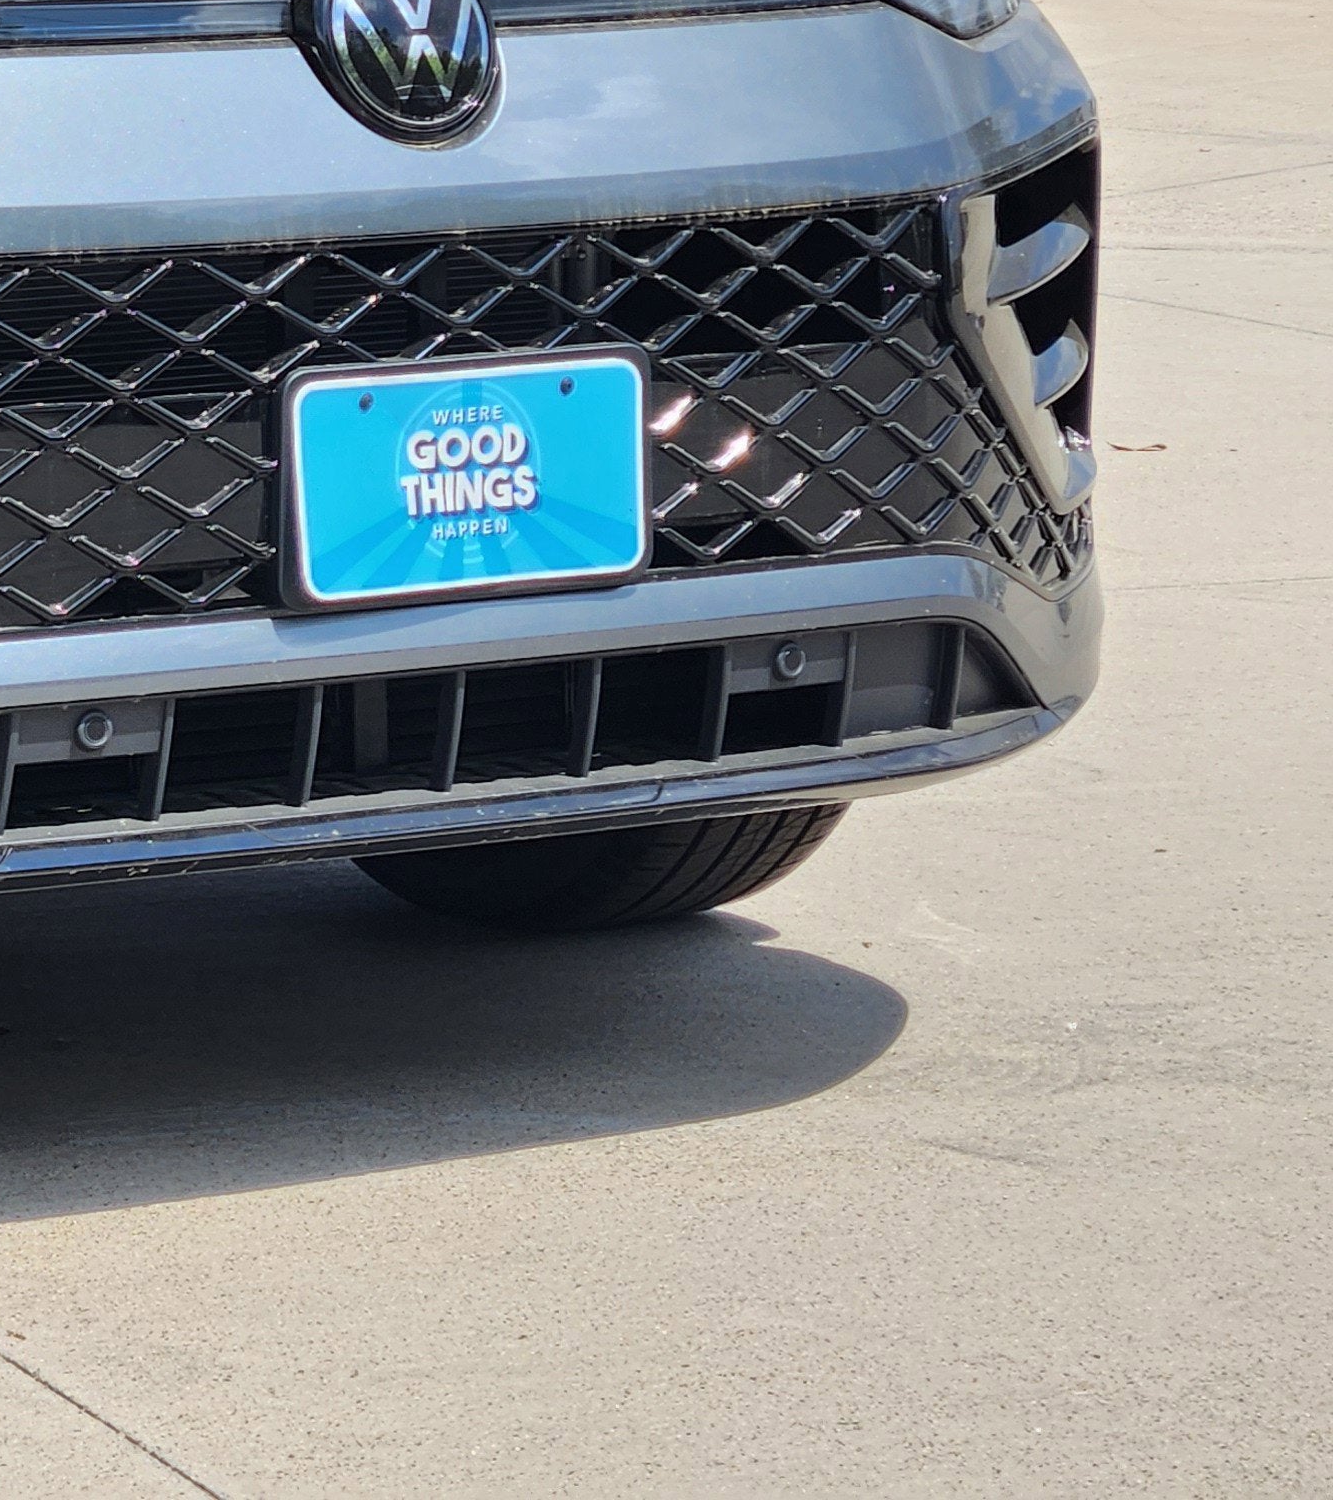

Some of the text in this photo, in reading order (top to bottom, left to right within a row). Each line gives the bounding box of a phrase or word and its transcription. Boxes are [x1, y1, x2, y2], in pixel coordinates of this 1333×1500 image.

[433, 405, 504, 426] WHERE
[406, 423, 529, 472] GOOD
[400, 465, 538, 520] THINGS
[433, 517, 509, 540] HAPPEN
